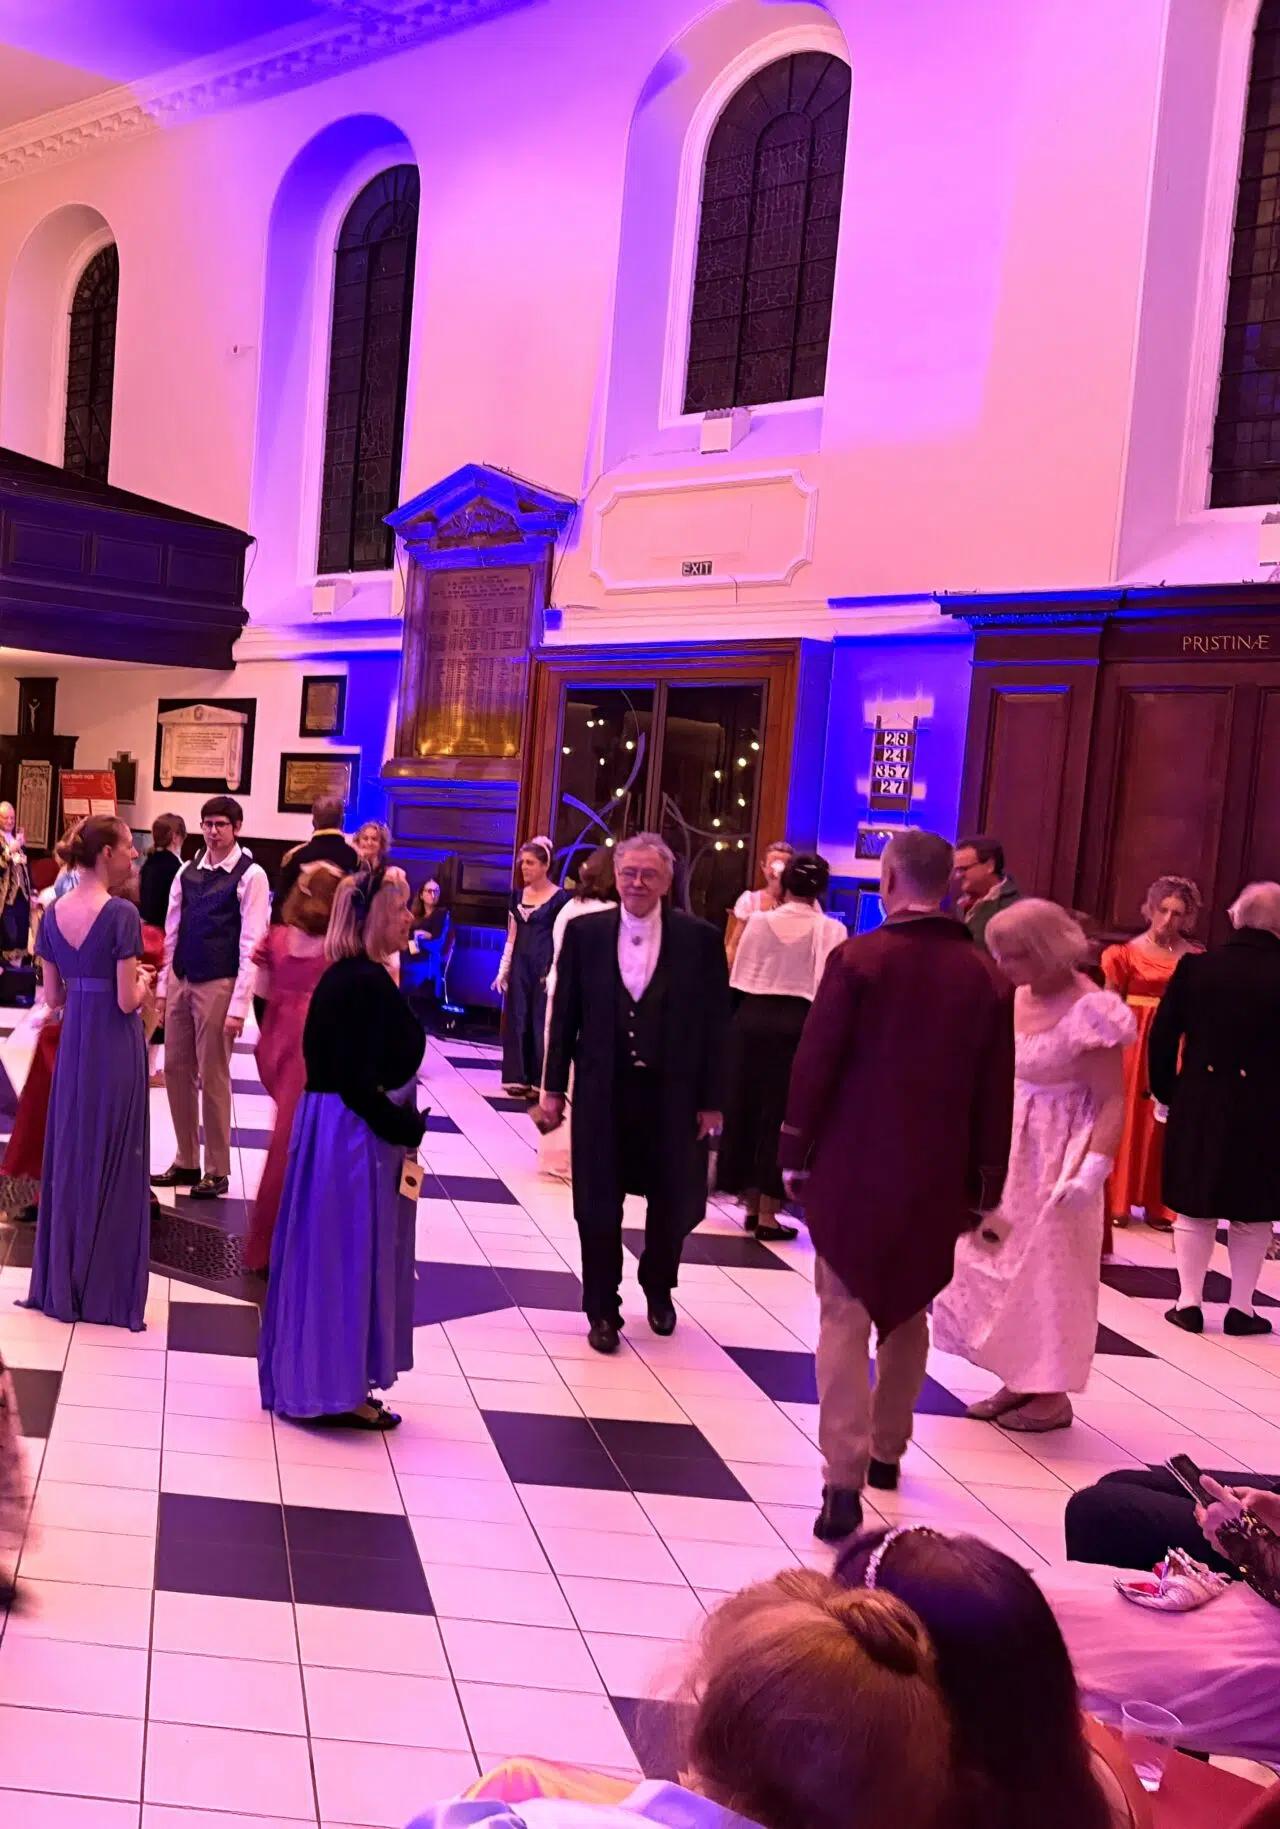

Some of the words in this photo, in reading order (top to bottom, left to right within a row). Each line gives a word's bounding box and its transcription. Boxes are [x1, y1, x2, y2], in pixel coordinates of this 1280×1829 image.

[683, 561, 712, 576] EXIT
[1183, 635, 1271, 653] PRISTINÆ
[886, 731, 906, 747] 28
[885, 748, 904, 762] 24
[877, 763, 908, 778] 357
[882, 779, 902, 794] 27
